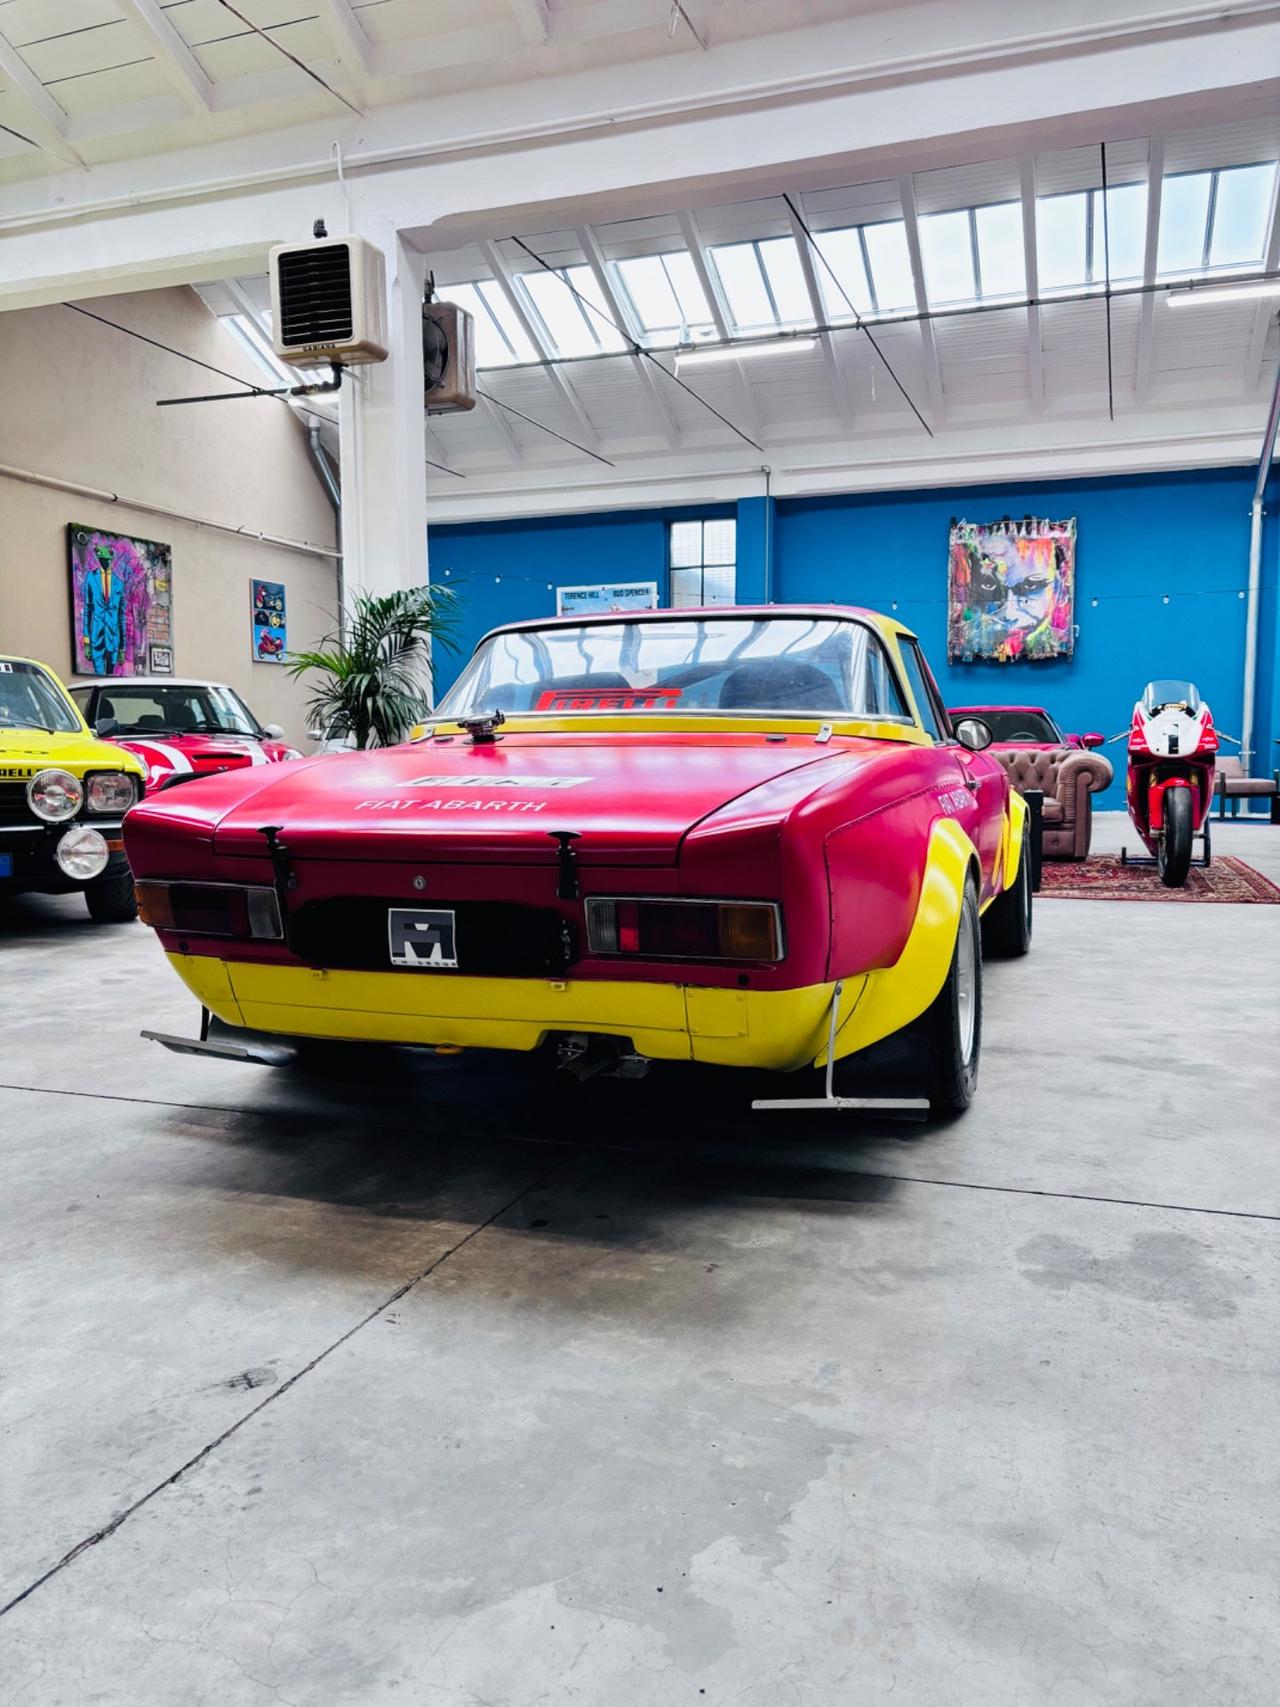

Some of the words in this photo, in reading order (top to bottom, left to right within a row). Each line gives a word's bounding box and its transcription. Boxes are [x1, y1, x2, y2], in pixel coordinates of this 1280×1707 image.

[564, 591, 587, 600] TERENCE
[588, 591, 600, 599] HILL
[354, 799, 422, 811] FIAT
[419, 799, 548, 812] ABARTH
